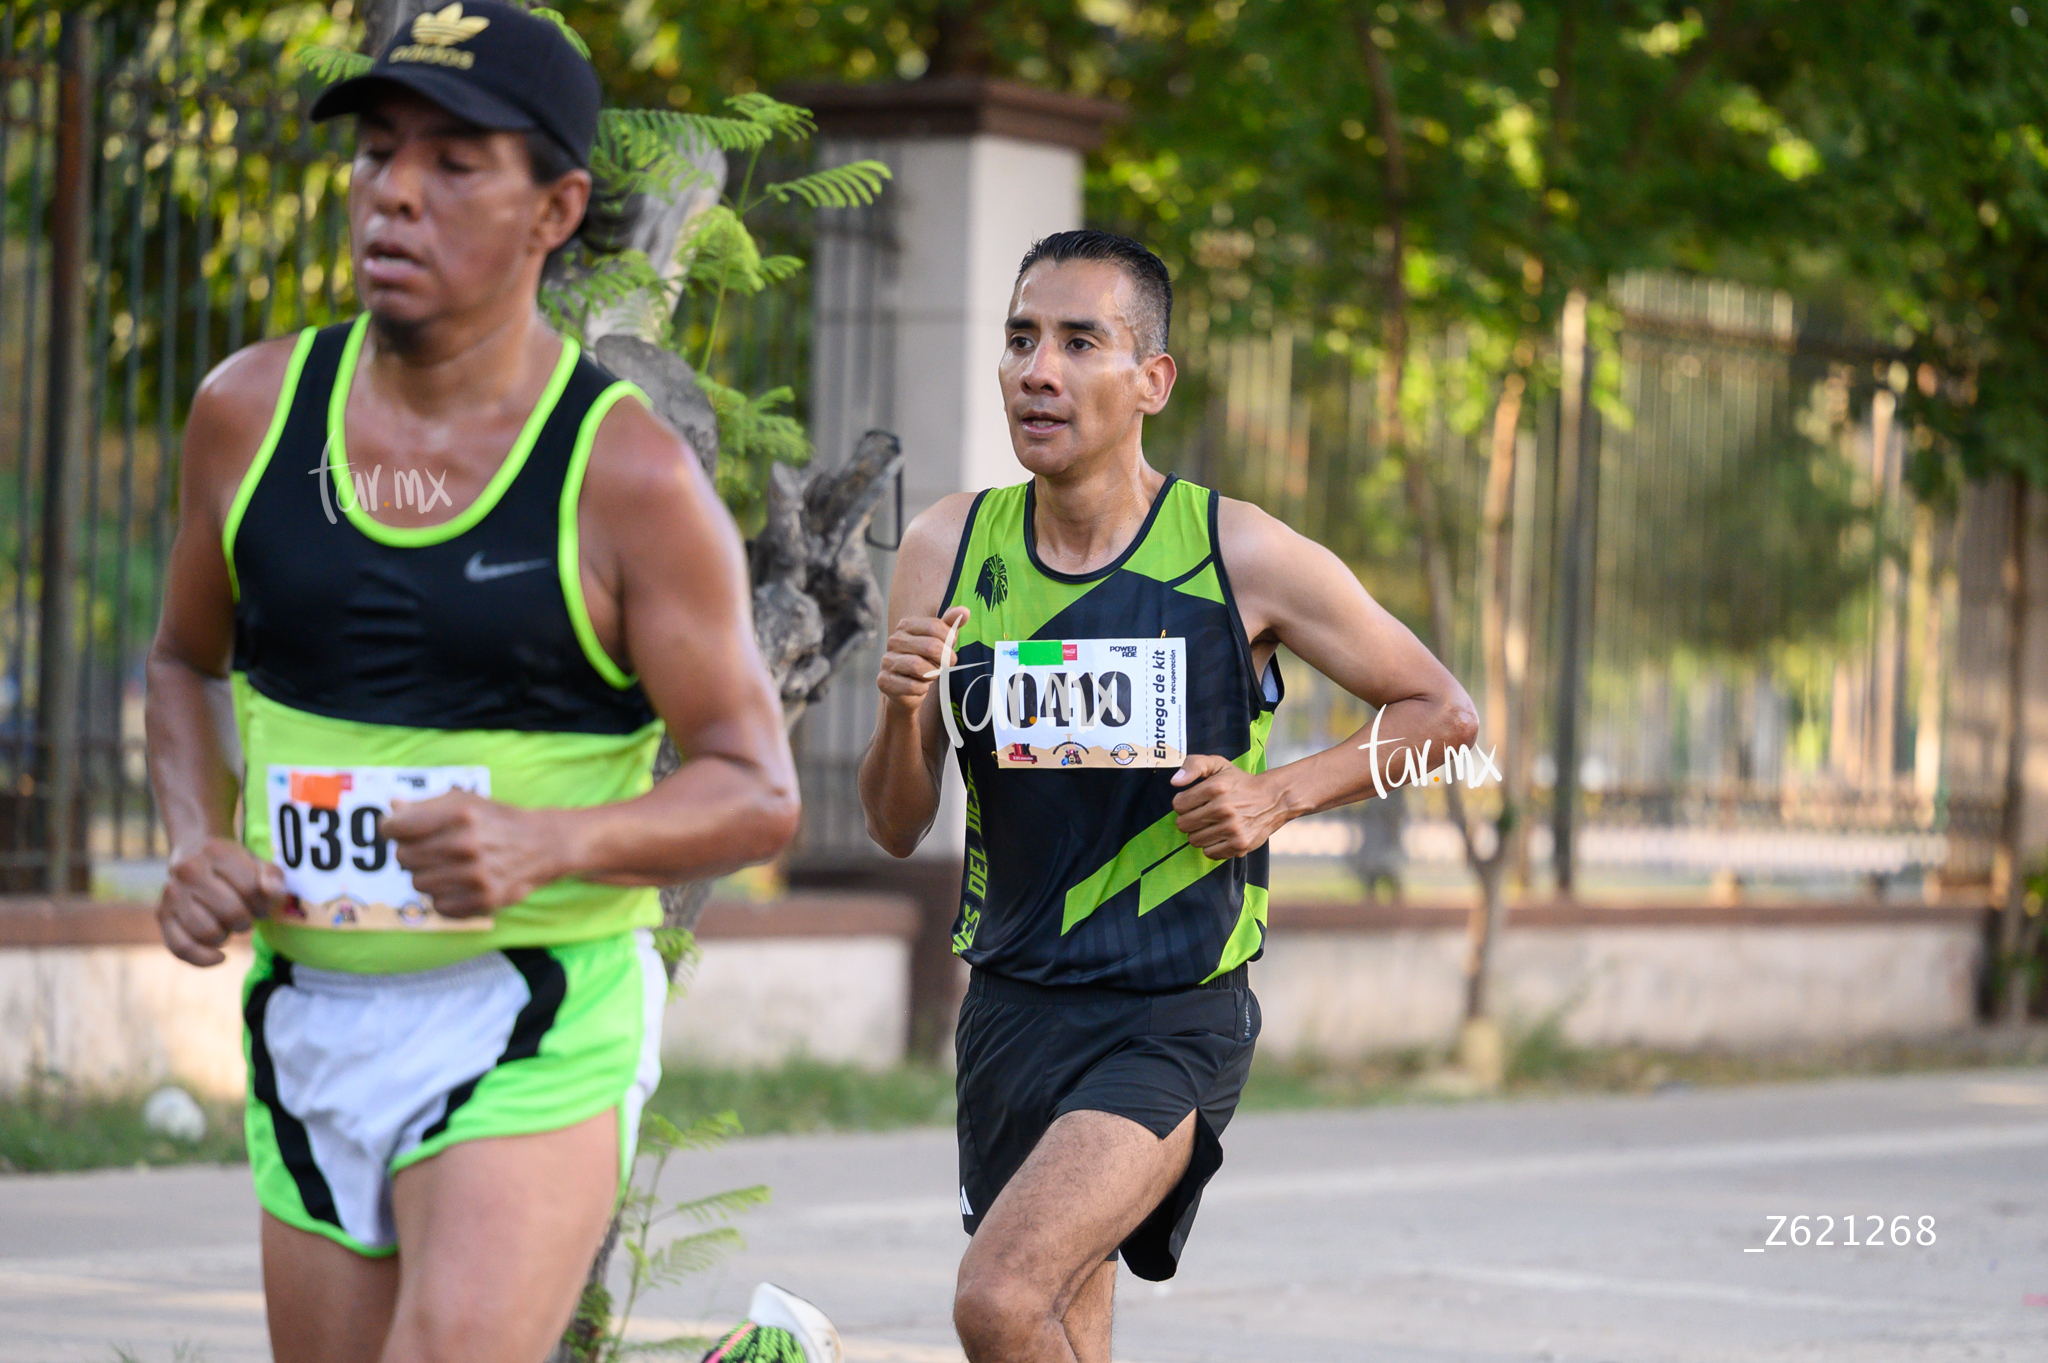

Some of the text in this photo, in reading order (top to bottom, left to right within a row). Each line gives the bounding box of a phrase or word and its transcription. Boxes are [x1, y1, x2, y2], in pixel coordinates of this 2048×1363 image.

[388, 44, 475, 70] adidas
[1007, 671, 1131, 728] 0410
[1152, 650, 1168, 759] Entrega de kit
[1169, 649, 1177, 704] de recuperación
[279, 803, 388, 873] 039
[968, 848, 988, 900] DEL
